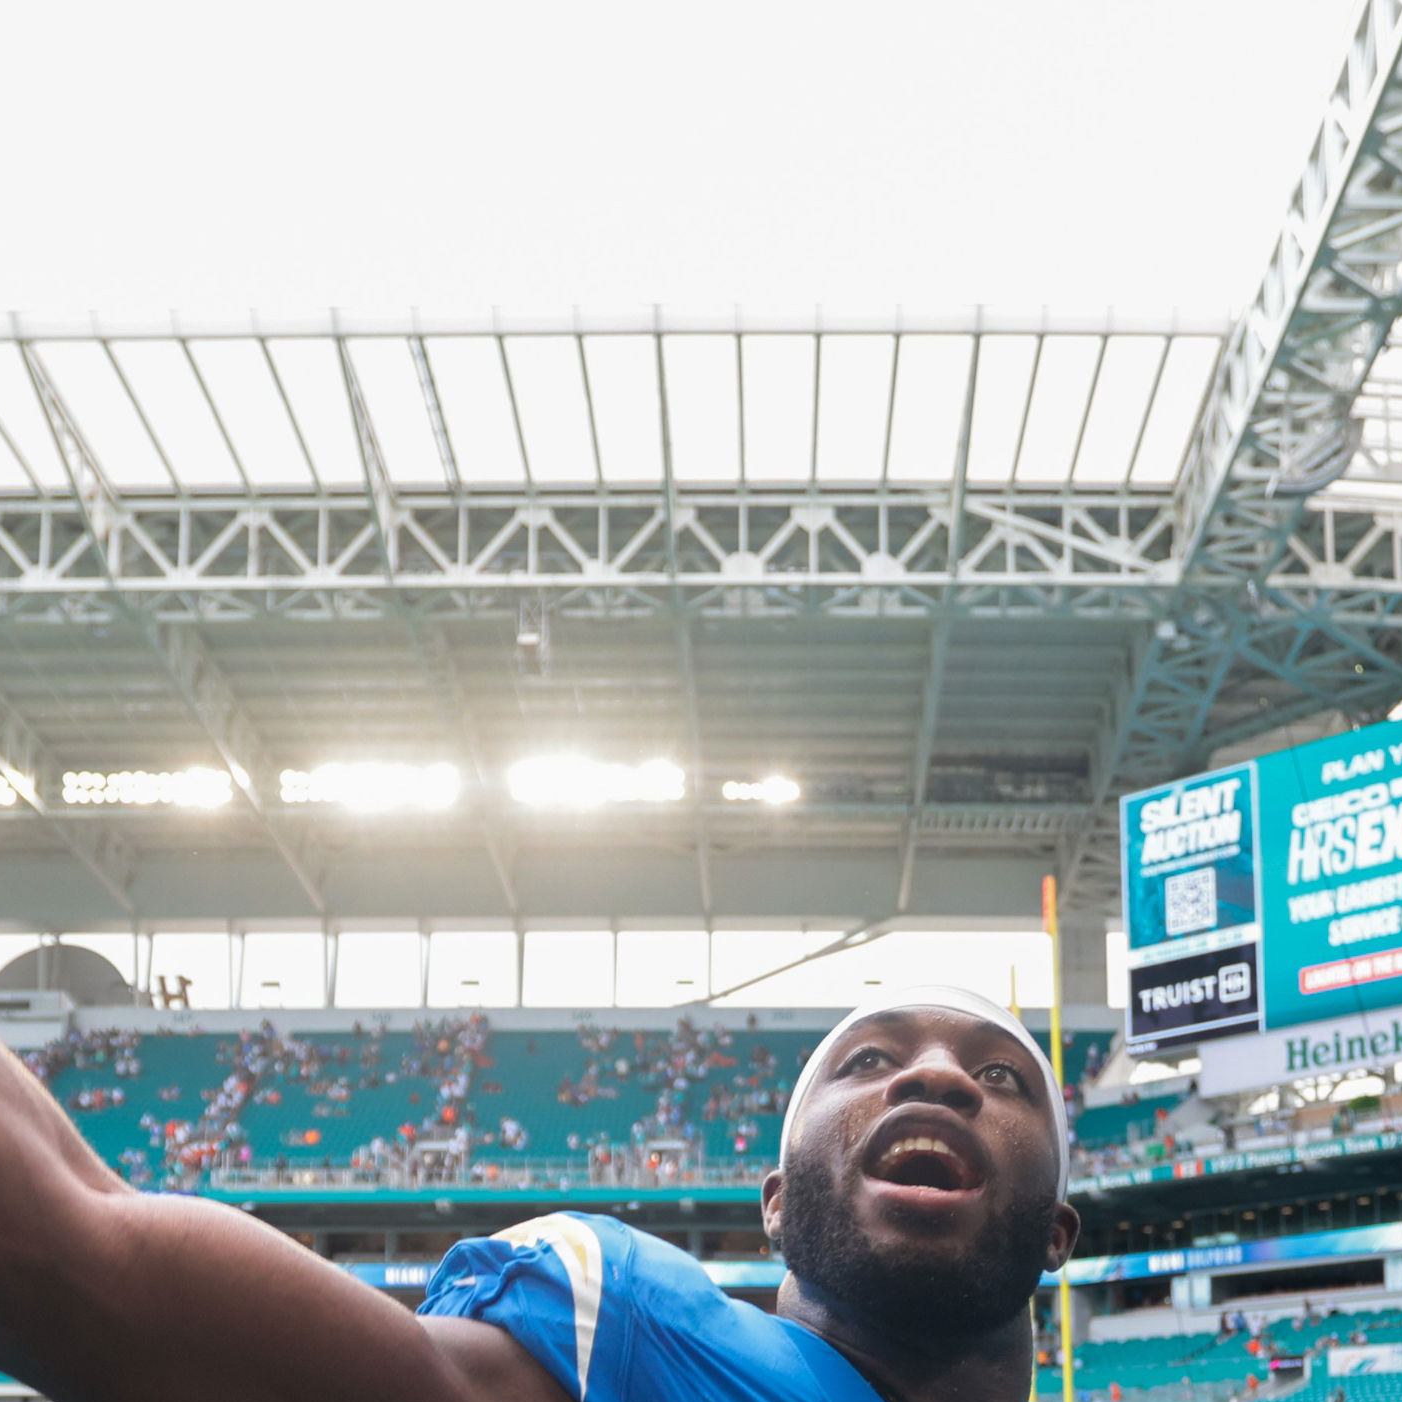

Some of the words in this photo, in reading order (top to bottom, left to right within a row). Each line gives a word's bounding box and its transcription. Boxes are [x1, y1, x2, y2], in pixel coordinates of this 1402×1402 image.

[1321, 749, 1385, 785] PLAN
[1139, 777, 1241, 834] SILENT
[1141, 809, 1242, 866] AUCTION
[1139, 975, 1218, 1013] TRUIST
